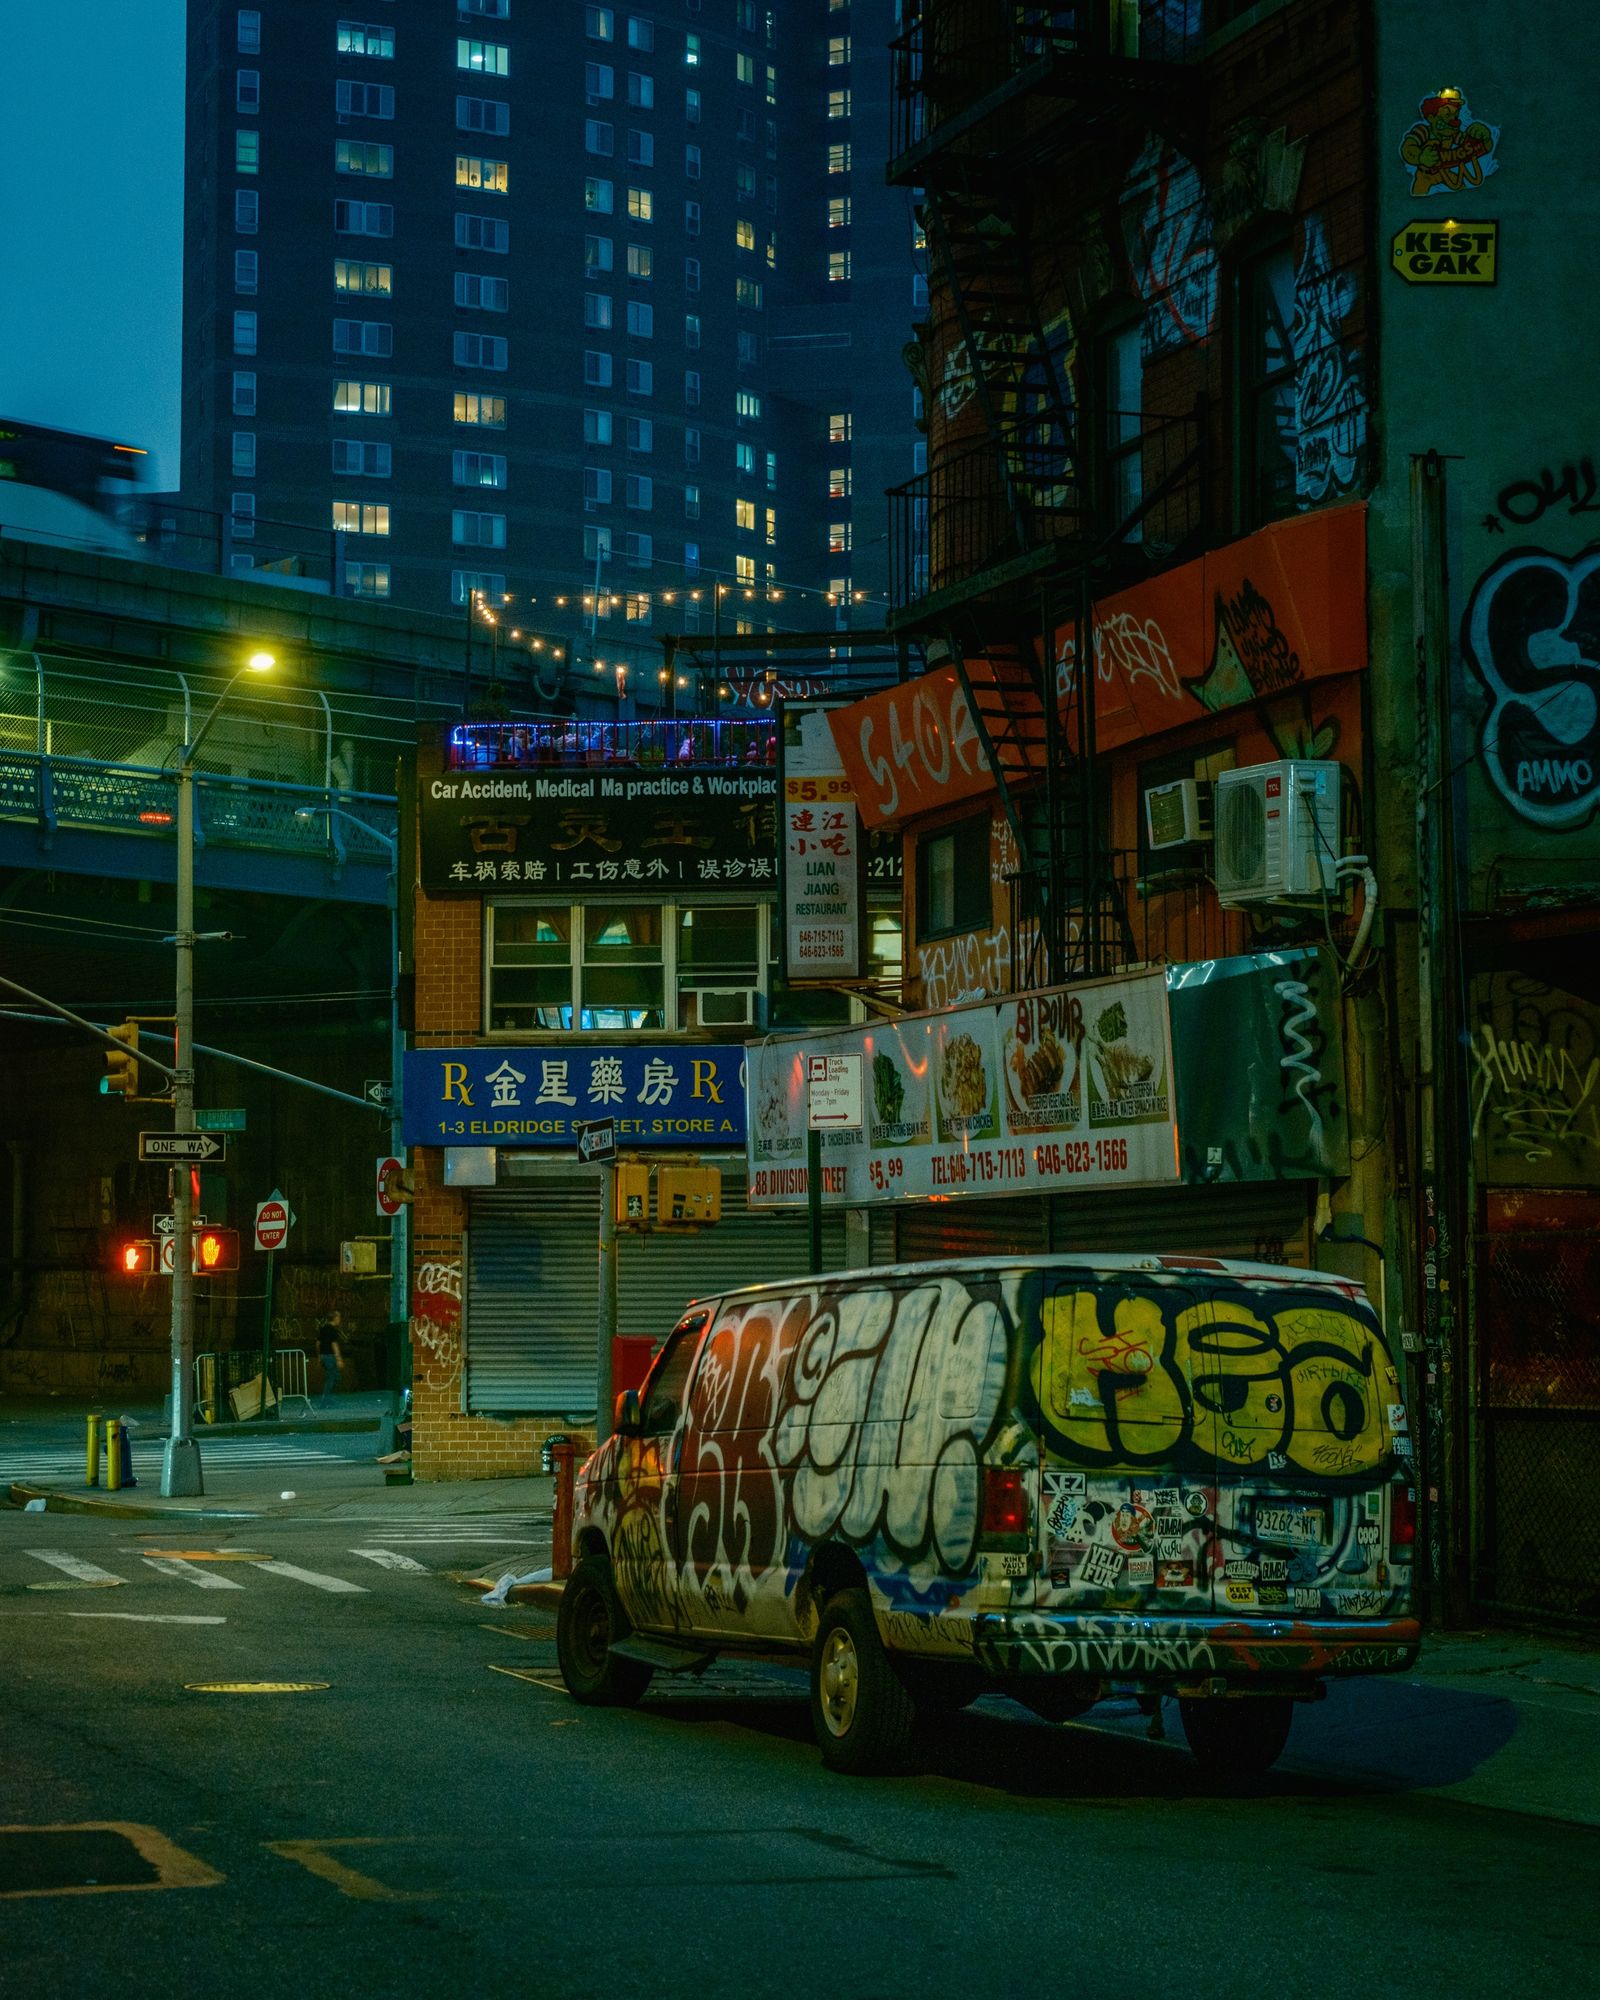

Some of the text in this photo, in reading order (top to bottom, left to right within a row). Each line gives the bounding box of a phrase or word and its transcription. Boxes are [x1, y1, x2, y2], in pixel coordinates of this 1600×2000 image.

[1405, 231, 1494, 253] KEST
[1409, 254, 1481, 275] GAK
[1516, 759, 1593, 798] AMMO
[430, 780, 457, 799] Car
[461, 779, 532, 801] Accident,
[535, 778, 594, 798] Medical
[691, 776, 705, 796] &
[788, 779, 852, 803] $5.99
[448, 861, 548, 882] 车祸索赔
[571, 859, 670, 882] 工伤意外
[805, 861, 836, 878] LIAN
[803, 881, 840, 898] JIANG
[796, 902, 848, 917] RESTAURANT
[799, 929, 845, 944] 646-715-7113
[799, 944, 846, 959] 646-623-1566
[828, 1058, 843, 1066] Truck
[828, 1066, 849, 1075] Loading
[828, 1074, 840, 1082] Only
[438, 1120, 465, 1136] 1-3
[470, 1119, 566, 1136] ELDRIDGE
[652, 1119, 715, 1135] STORE
[717, 1119, 739, 1135] A.
[152, 1141, 213, 1152] ONE WAY
[931, 1147, 1026, 1185] TEL:646-715-7113
[1036, 1138, 1128, 1176] 646-623-1566
[755, 1170, 767, 1196] 88
[820, 1166, 847, 1193] TREET
[869, 1157, 903, 1190] $5.99
[262, 1210, 283, 1220] DO NOT
[262, 1232, 280, 1241] ENTER
[1157, 1518, 1182, 1537] GUMBA
[1358, 1526, 1379, 1545] COOP
[1088, 1545, 1123, 1575] VELO
[1081, 1565, 1118, 1590] FUK
[1262, 1561, 1286, 1580] GUMBA
[1231, 1592, 1250, 1600] GAK
[1295, 1587, 1321, 1609] GUMBA
